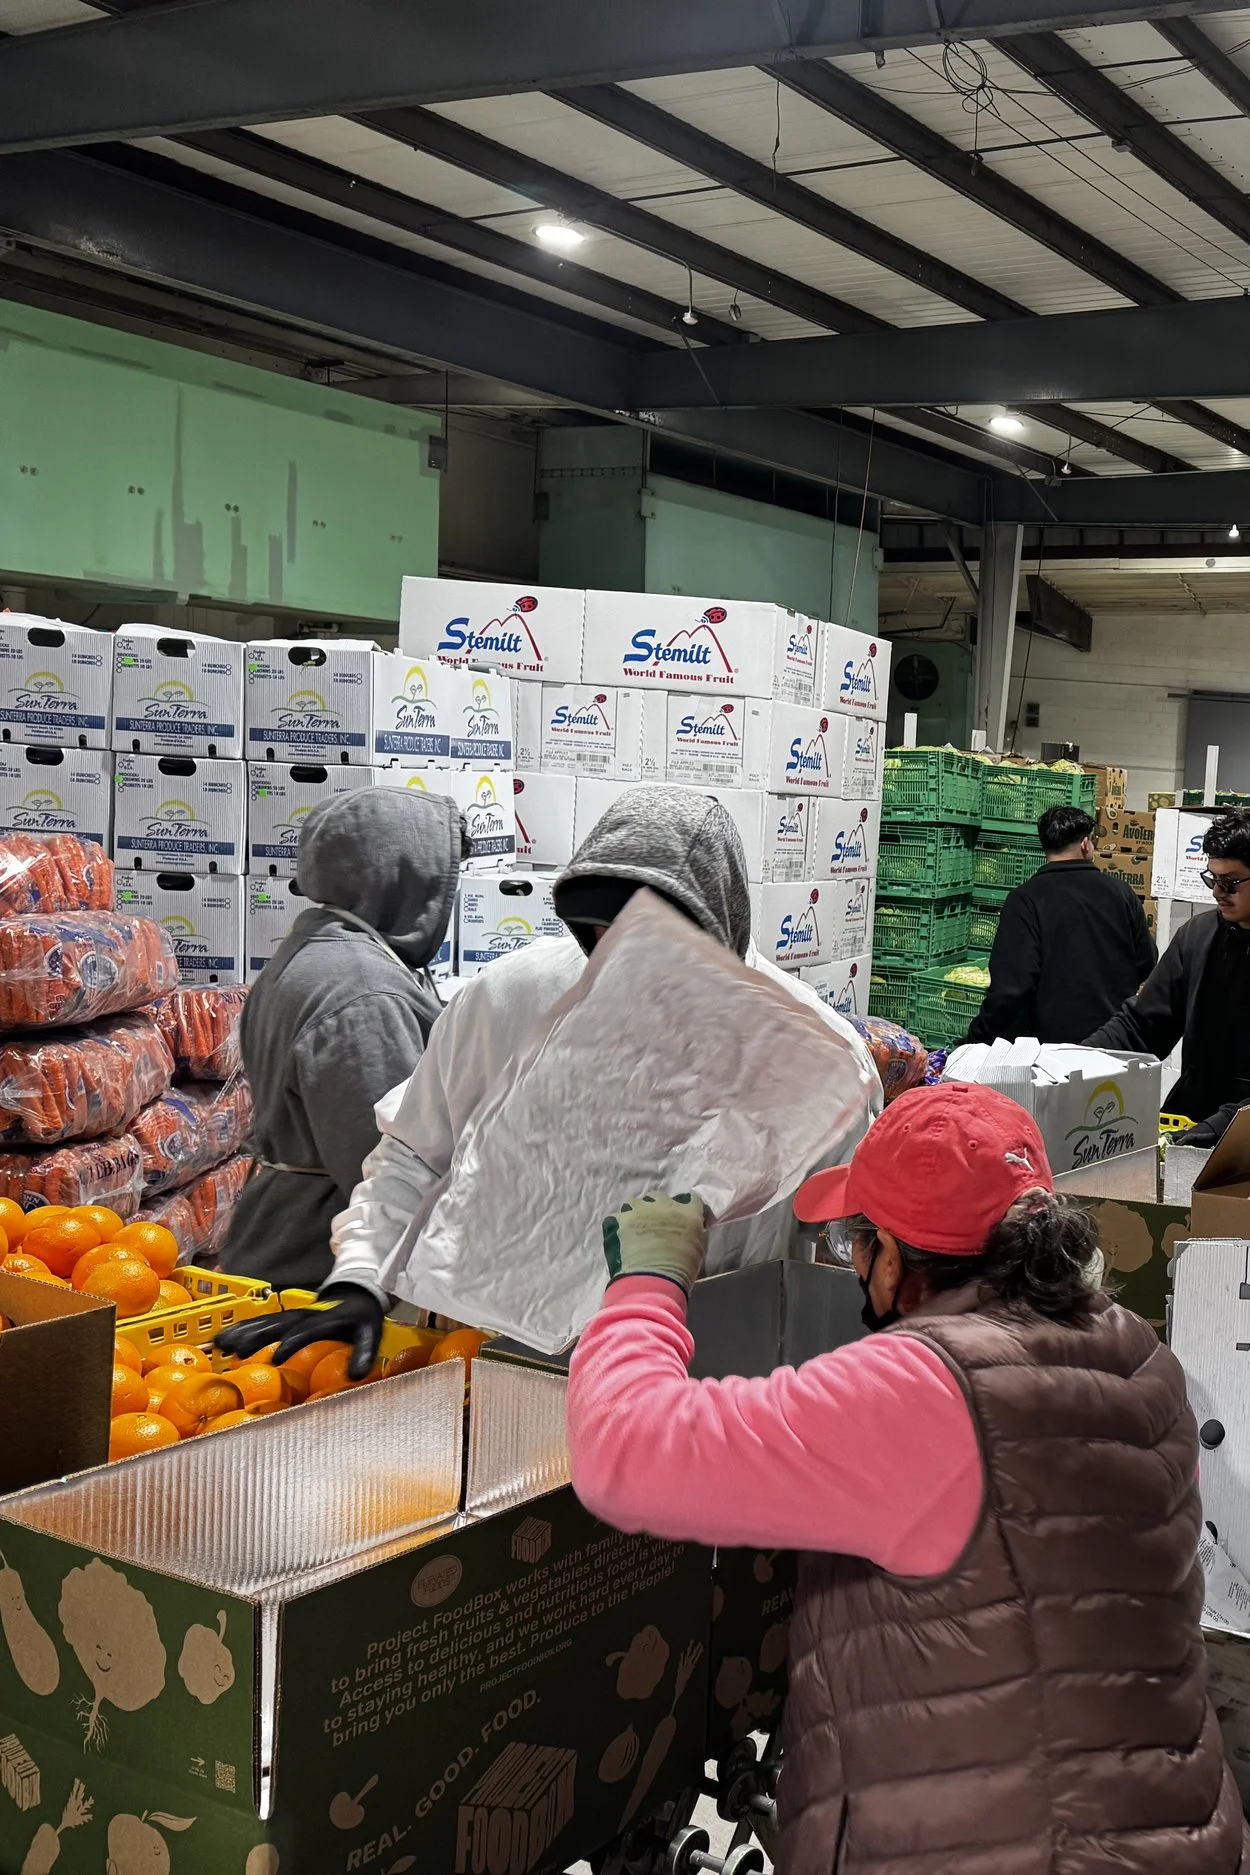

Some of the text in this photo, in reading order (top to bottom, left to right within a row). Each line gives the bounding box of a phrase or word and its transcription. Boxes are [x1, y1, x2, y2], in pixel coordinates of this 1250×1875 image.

[437, 617, 523, 653] Stemilt
[622, 629, 712, 665] Stemilt
[787, 634, 808, 656] Stemilt
[517, 663, 544, 673] Fruit
[623, 668, 734, 685] World Famous Fruit
[840, 661, 871, 693] Stemilt
[15, 694, 79, 711] SunTerra
[144, 703, 208, 719] SunTerra
[839, 696, 852, 705] World
[867, 700, 877, 710] Fruit
[26, 712, 53, 724] PRODUCE
[278, 713, 341, 729] SunTerra
[395, 704, 436, 730] SunTerra
[550, 706, 599, 726] Stemilt
[129, 720, 155, 731] SUNTERRA
[156, 722, 181, 732] PRODUCE
[570, 728, 594, 736] Famous
[676, 716, 725, 736] Stemilt
[263, 731, 289, 741] SUNTERRA
[290, 732, 315, 742] PRODUCE
[696, 738, 722, 746] Famous
[785, 738, 822, 772] Stemilt
[855, 738, 871, 755] Stemilt
[785, 776, 800, 785] World
[800, 778, 818, 786] Famous
[12, 812, 77, 828] SunTerra
[777, 815, 799, 834] Stemilt
[146, 822, 209, 837] SunTerra
[131, 839, 157, 849] SUNTERRA
[158, 840, 183, 851] PRODUCE
[265, 846, 291, 857] SUNTERRA
[517, 846, 532, 854] uit
[831, 831, 862, 863] Stemilt
[830, 866, 842, 874] World
[845, 899, 861, 916] Stemilt
[776, 914, 814, 951] Stemilt
[173, 938, 209, 954] Terra
[775, 953, 790, 962] World
[808, 949, 820, 957] Fruit
[1072, 1128, 1135, 1170] SunTerra
[367, 1532, 625, 1660] Project FoodBox works with family
[331, 1537, 642, 1694] to bring fresh fruits & vegetables directly
[339, 1546, 649, 1708] Access to delicious and nutritious food is
[323, 1544, 685, 1734] to staying healthy, and we work hard every day to
[332, 1561, 676, 1748] bring you only the best. Produce to the People!
[479, 1638, 573, 1693] PROJECTFOODBOX.ORG
[346, 1689, 541, 1872] REAL. GOOD. FOOD.
[454, 1804, 529, 1874] FOOD
